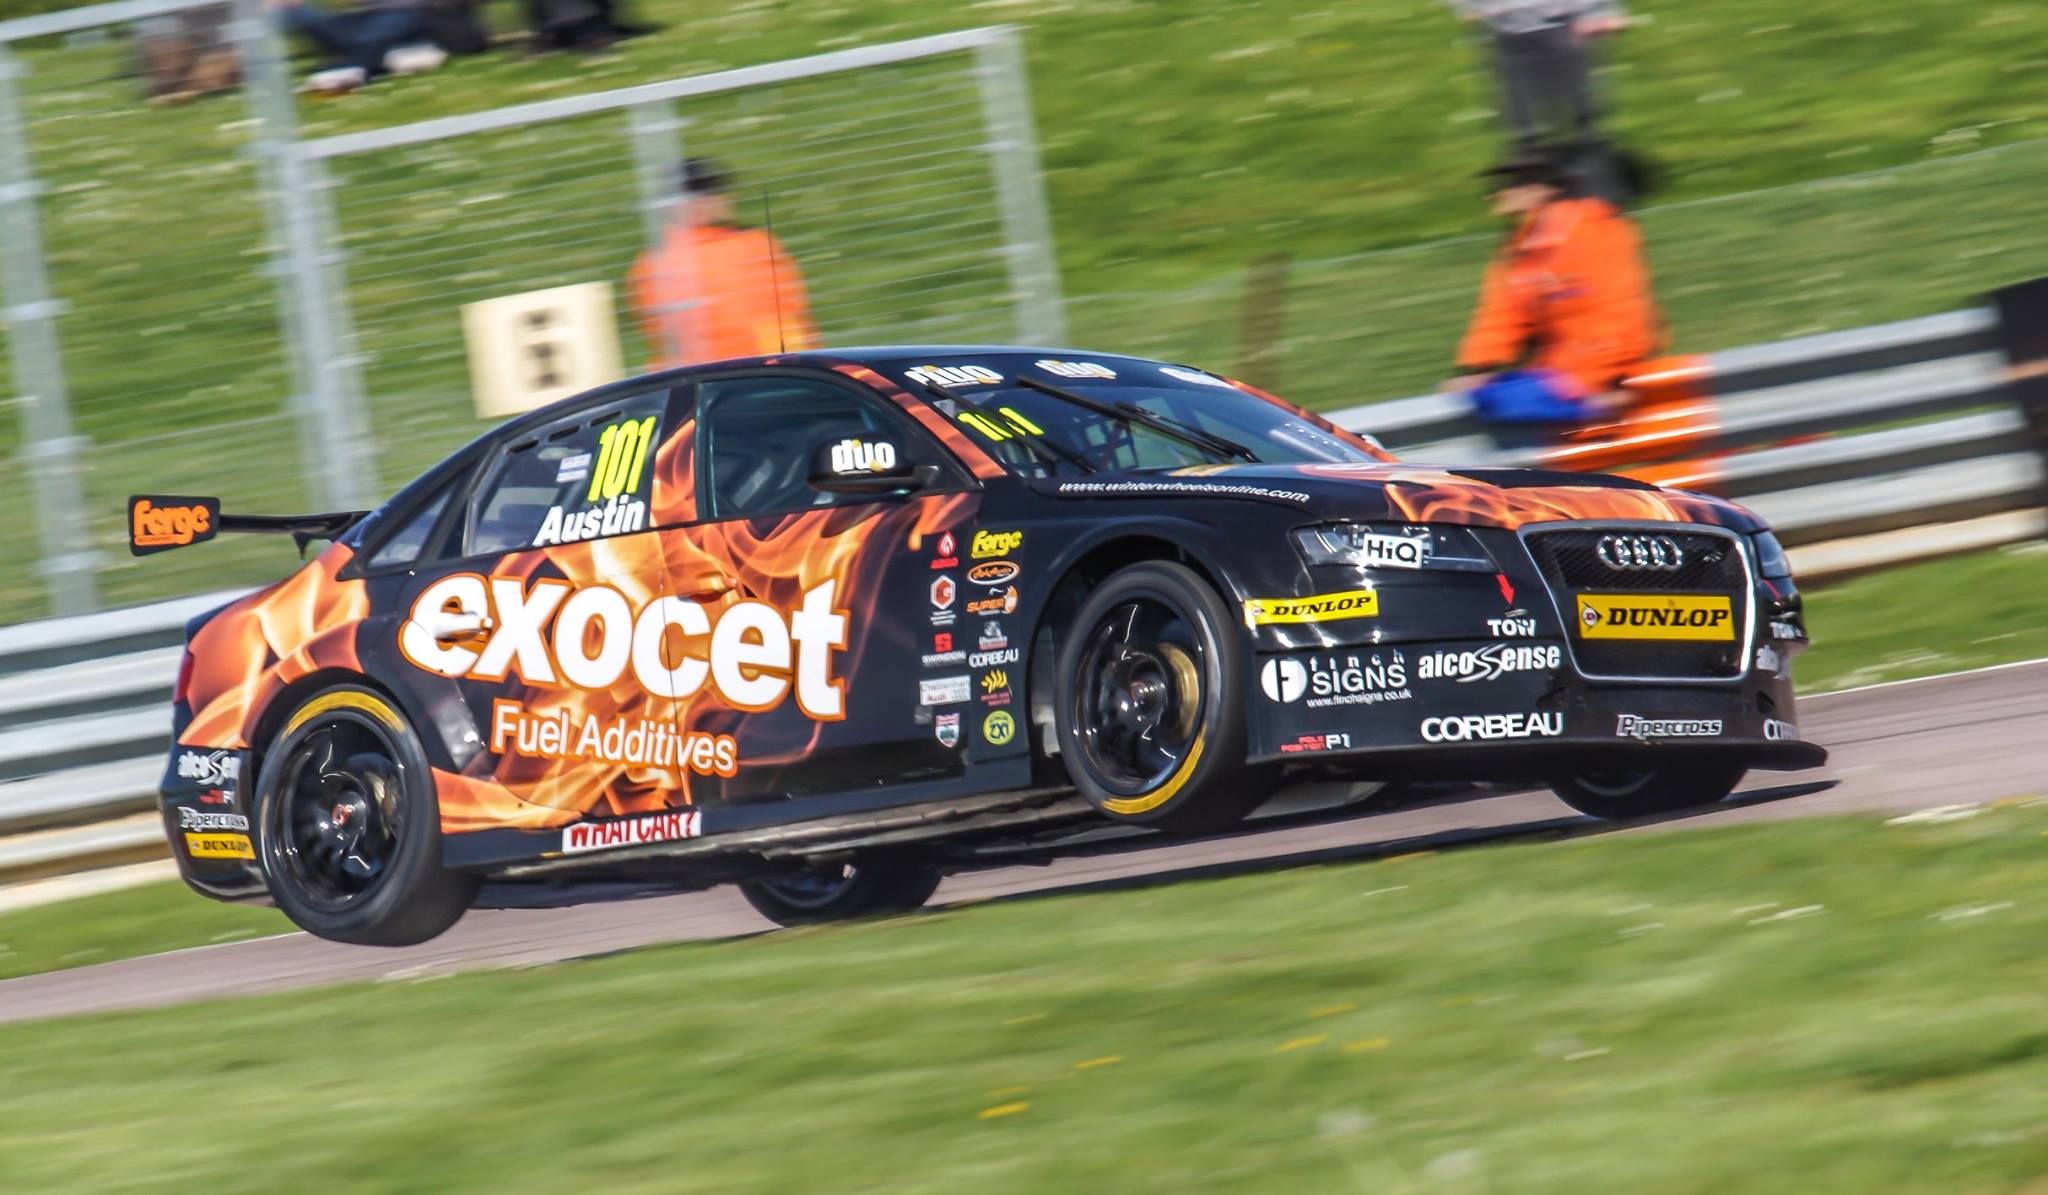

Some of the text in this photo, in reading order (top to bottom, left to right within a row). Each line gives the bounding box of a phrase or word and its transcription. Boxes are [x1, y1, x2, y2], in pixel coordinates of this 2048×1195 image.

[588, 416, 657, 502] 101
[831, 439, 896, 473] duo
[1058, 480, 1311, 503] www.winterwheelsonline.com
[533, 495, 646, 547] Austin
[1366, 539, 1418, 563] HiQ
[1272, 596, 1372, 616] DUNLOP
[1606, 606, 1729, 628] DUNLOP
[1486, 618, 1537, 638] TOW
[401, 575, 848, 719] exocet
[968, 648, 1020, 669] CORBEAU
[1311, 664, 1408, 695] SIGNS
[494, 704, 737, 772] Fuel Additives
[1420, 713, 1562, 743] CORBEAU
[1615, 713, 1724, 740] Pipercross
[203, 839, 249, 852] DUNLOP
